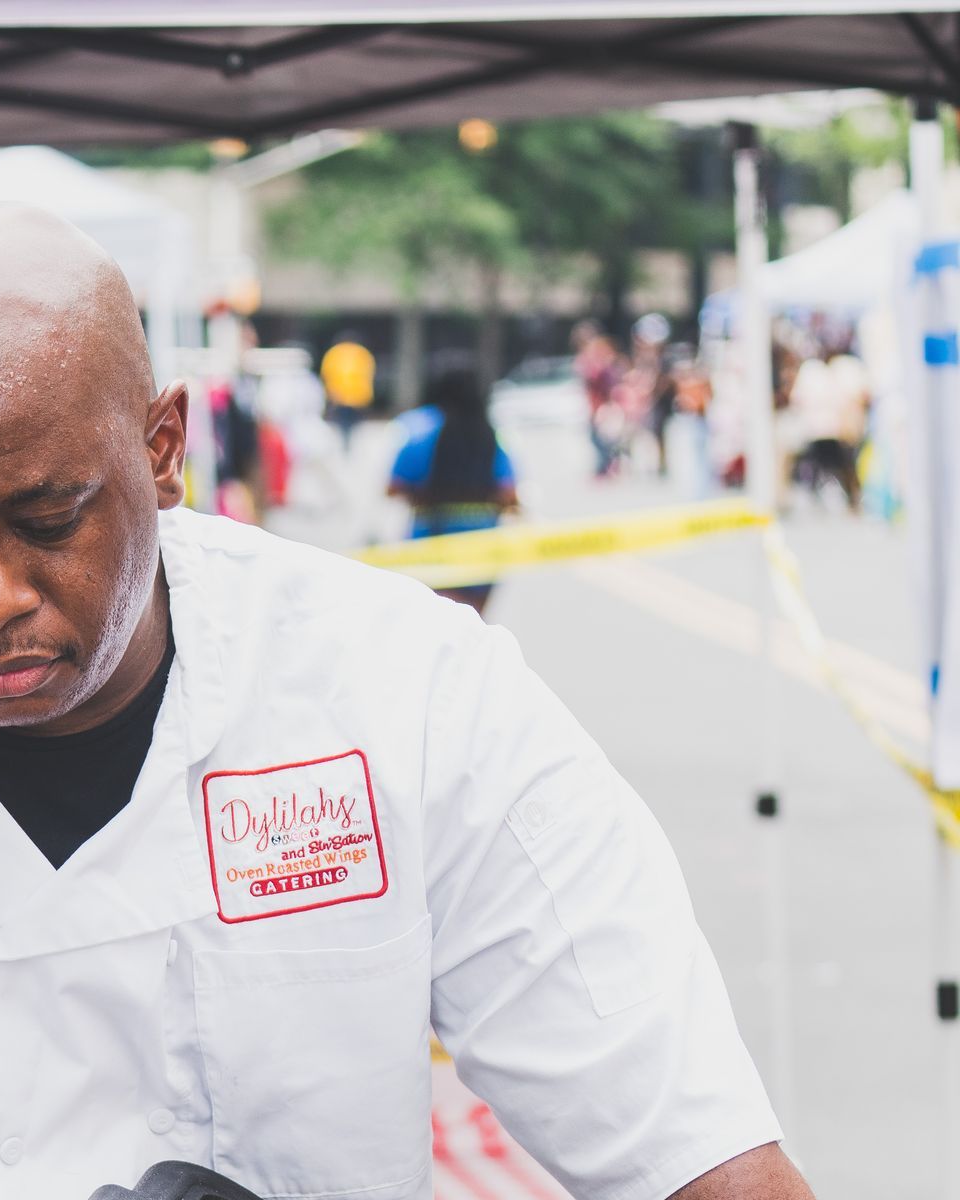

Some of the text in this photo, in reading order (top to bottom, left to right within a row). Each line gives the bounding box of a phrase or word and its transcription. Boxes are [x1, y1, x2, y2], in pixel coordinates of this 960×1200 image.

[221, 787, 356, 852] Dylilahs
[226, 847, 368, 883] Oven Roasted Wings
[281, 847, 305, 860] and
[251, 867, 348, 897] CATERING
